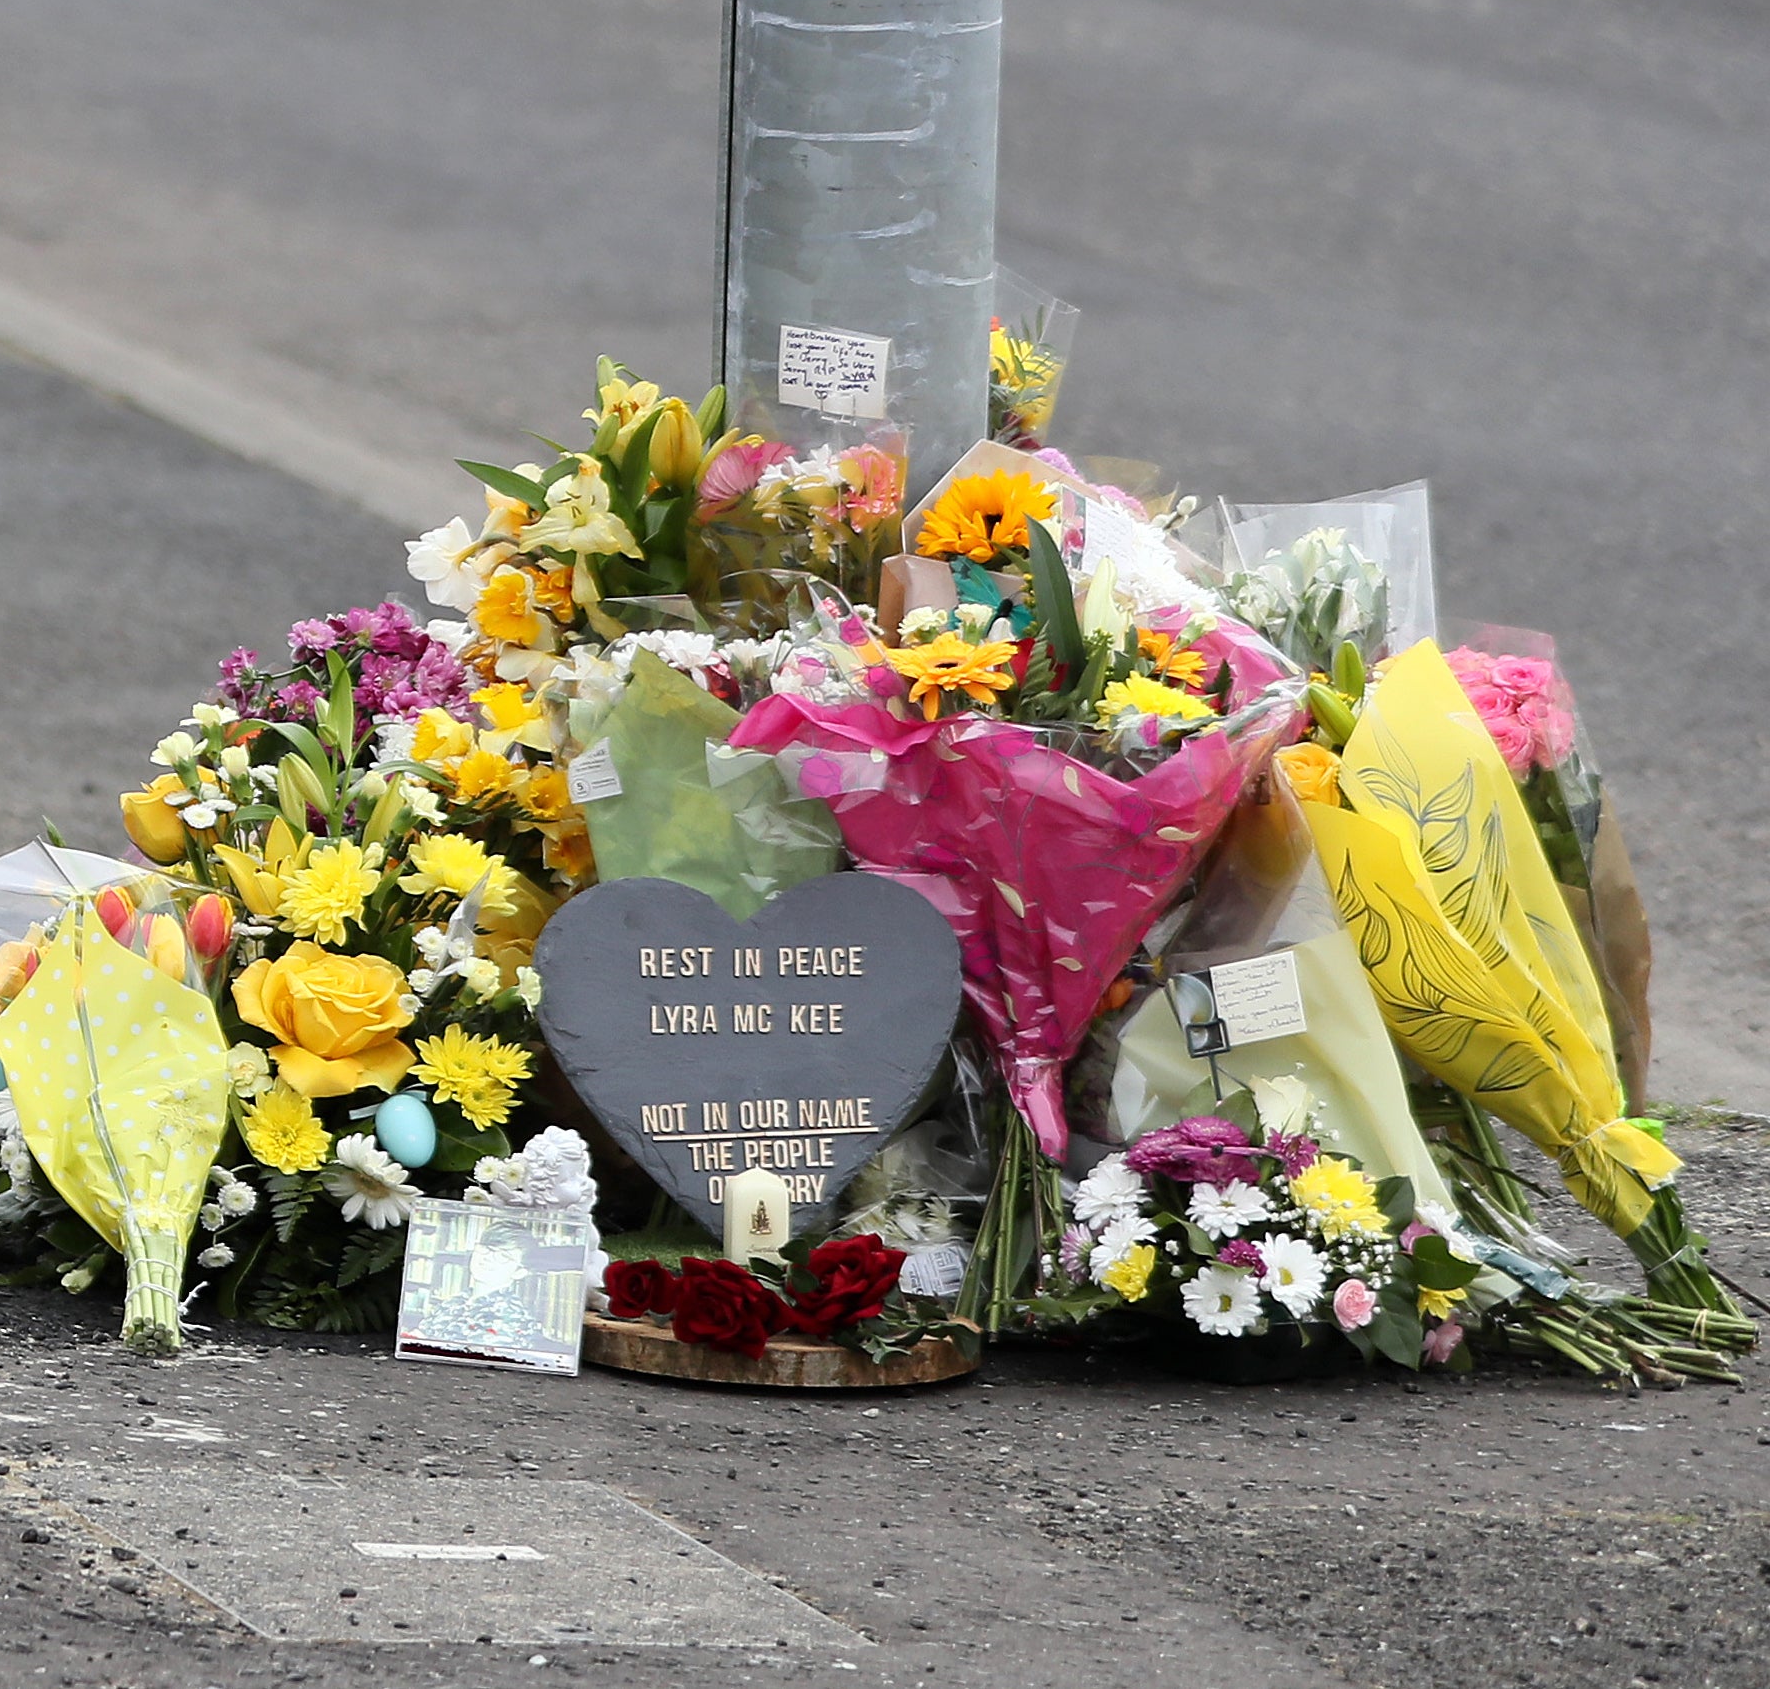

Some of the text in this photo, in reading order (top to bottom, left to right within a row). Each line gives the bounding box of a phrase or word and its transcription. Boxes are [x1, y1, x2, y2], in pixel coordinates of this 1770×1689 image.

[639, 946, 864, 977] REST IN PEACE
[650, 1004, 843, 1034] LYRA MC KEE
[641, 1098, 872, 1133] NOT IN OUR NAME
[687, 1138, 835, 1171] THE PEOPLE
[708, 1175, 734, 1204] O
